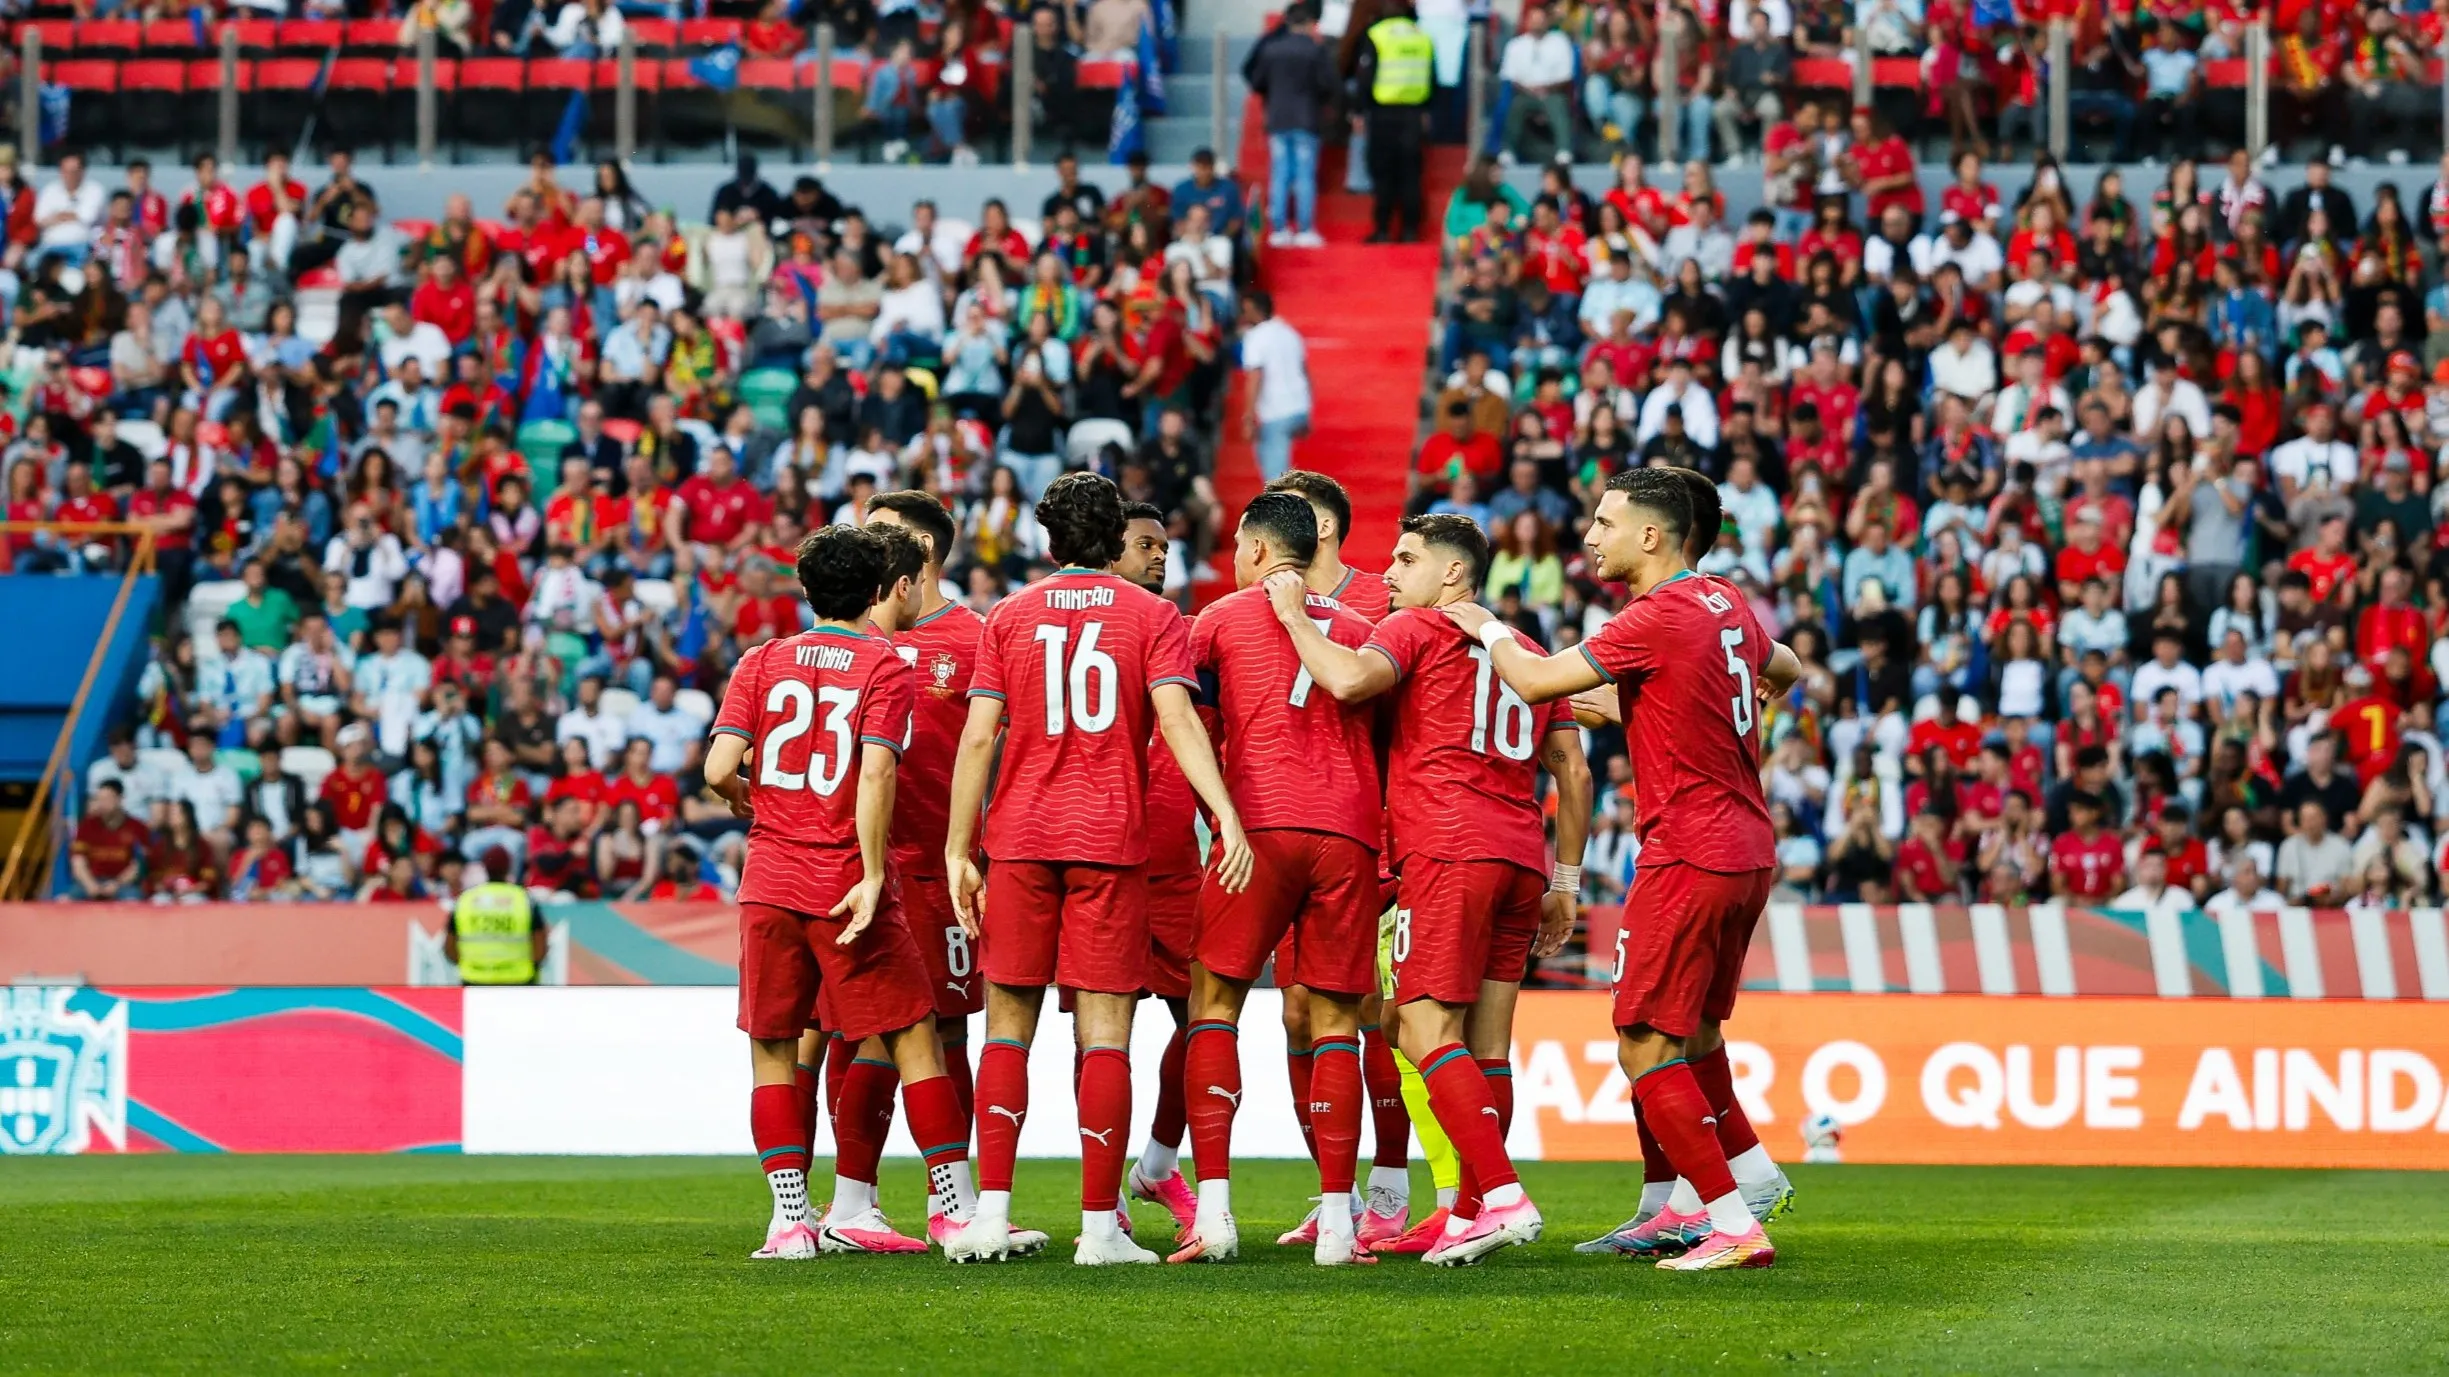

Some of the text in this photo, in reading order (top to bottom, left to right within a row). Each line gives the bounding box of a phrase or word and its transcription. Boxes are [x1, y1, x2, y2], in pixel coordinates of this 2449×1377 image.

[796, 645, 855, 671] VITINHA
[1033, 622, 1118, 736] 16
[1720, 626, 1753, 737] 5
[760, 679, 860, 796] 23
[946, 927, 971, 977] 8
[1393, 908, 1411, 963] 8
[1612, 928, 1630, 983] 5
[1801, 1040, 1888, 1126] O
[1920, 1041, 2144, 1130] QUE
